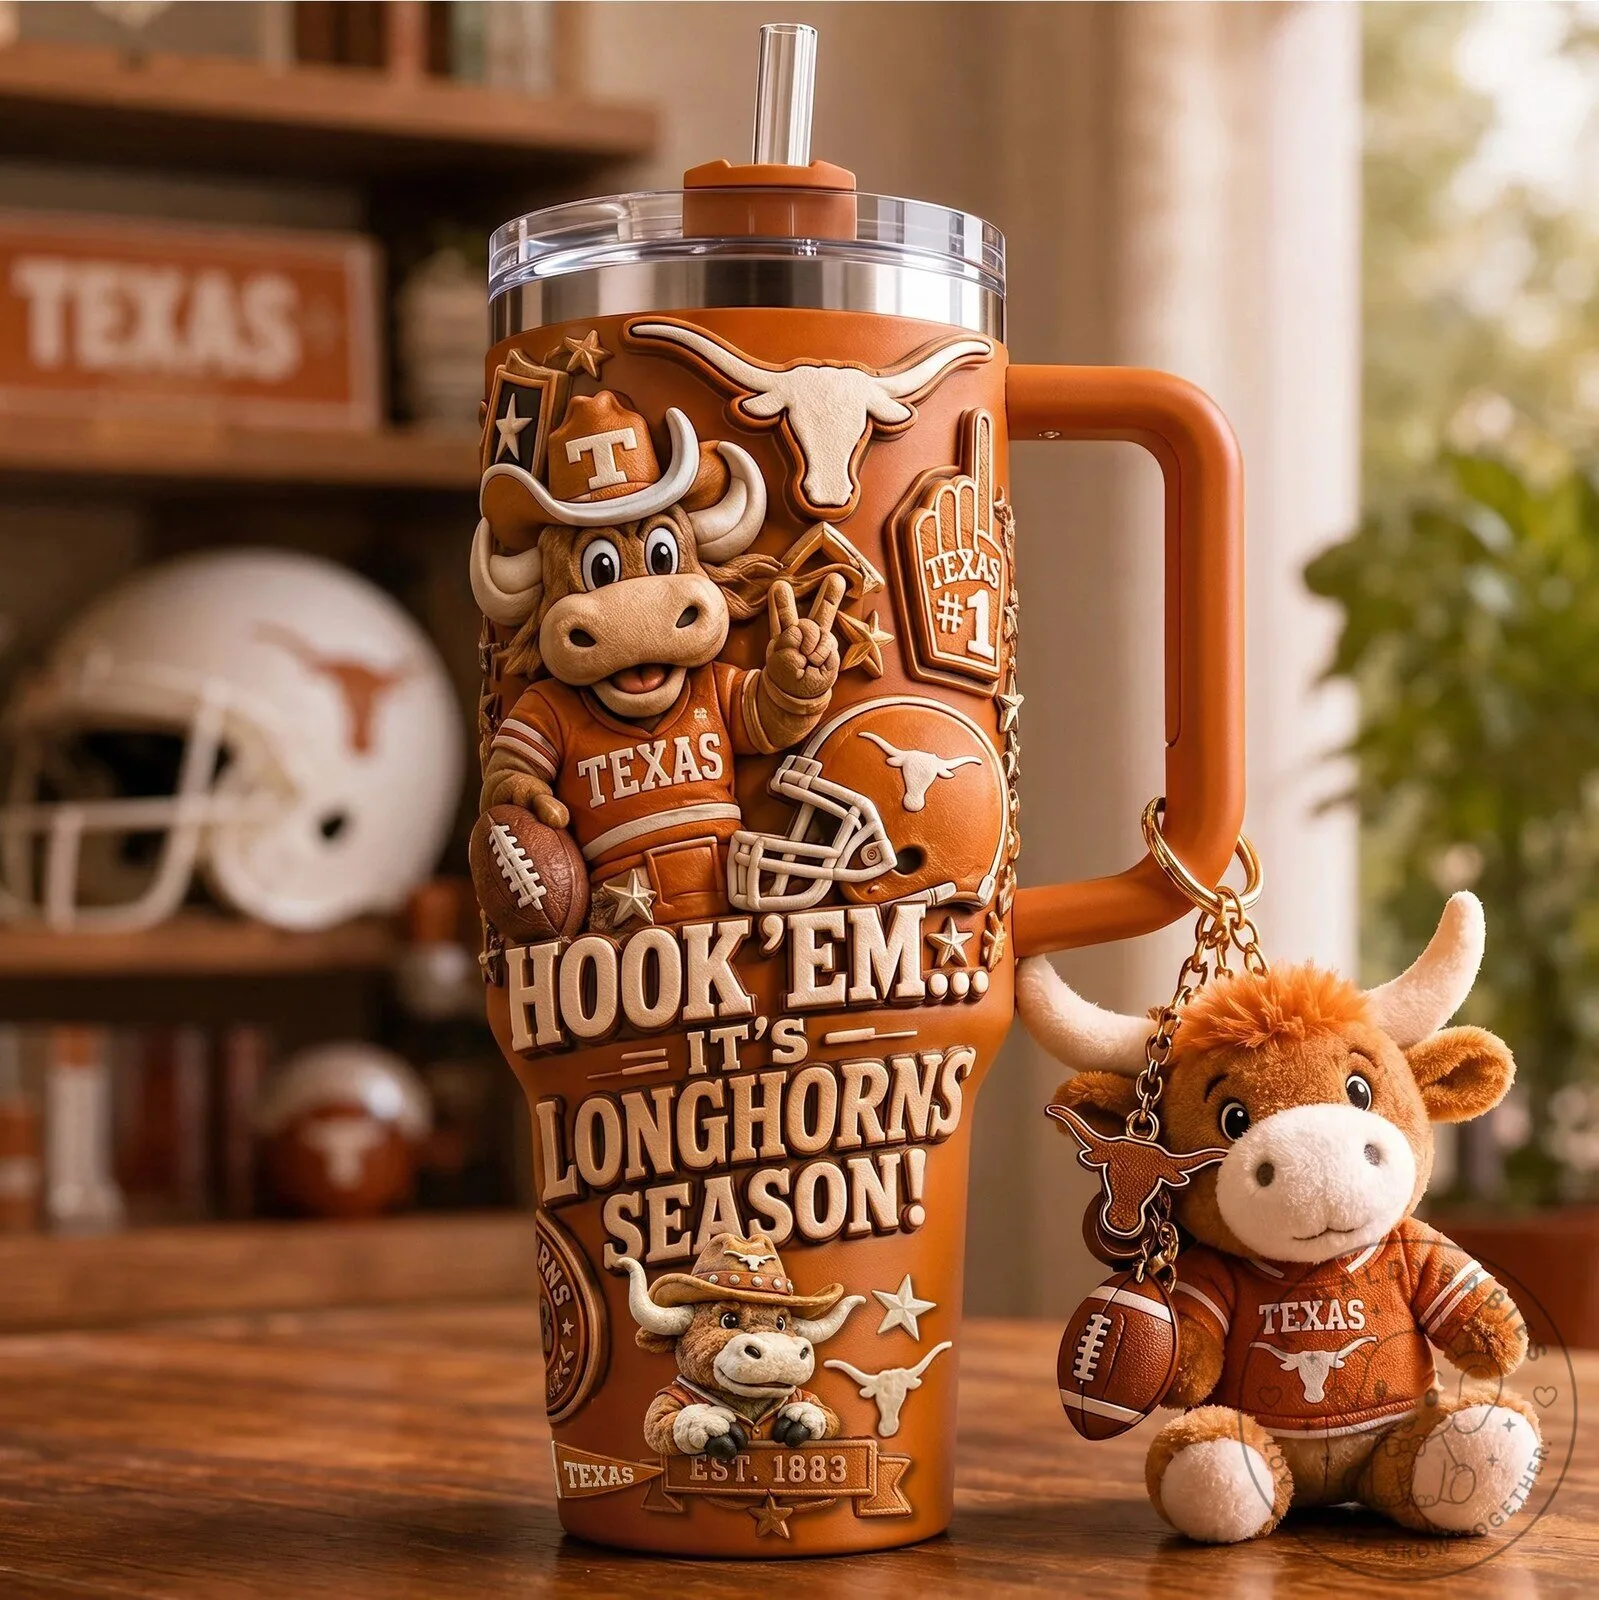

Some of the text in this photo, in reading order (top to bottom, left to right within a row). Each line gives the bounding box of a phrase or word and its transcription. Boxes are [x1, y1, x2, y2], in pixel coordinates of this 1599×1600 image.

[11, 256, 301, 384] TEXAS
[565, 427, 637, 490] T
[925, 548, 1001, 590] TEXAS
[936, 589, 995, 660] #1
[577, 732, 724, 809] TEXAS
[505, 914, 754, 1053] HOOK
[687, 1017, 809, 1075] IT'S
[535, 1045, 978, 1203] LONGHORNS
[603, 1148, 927, 1271] SEASON!
[1258, 1298, 1366, 1335] TEXAS
[563, 1460, 634, 1489] TEXAS
[689, 1453, 847, 1484] EST. 1883
